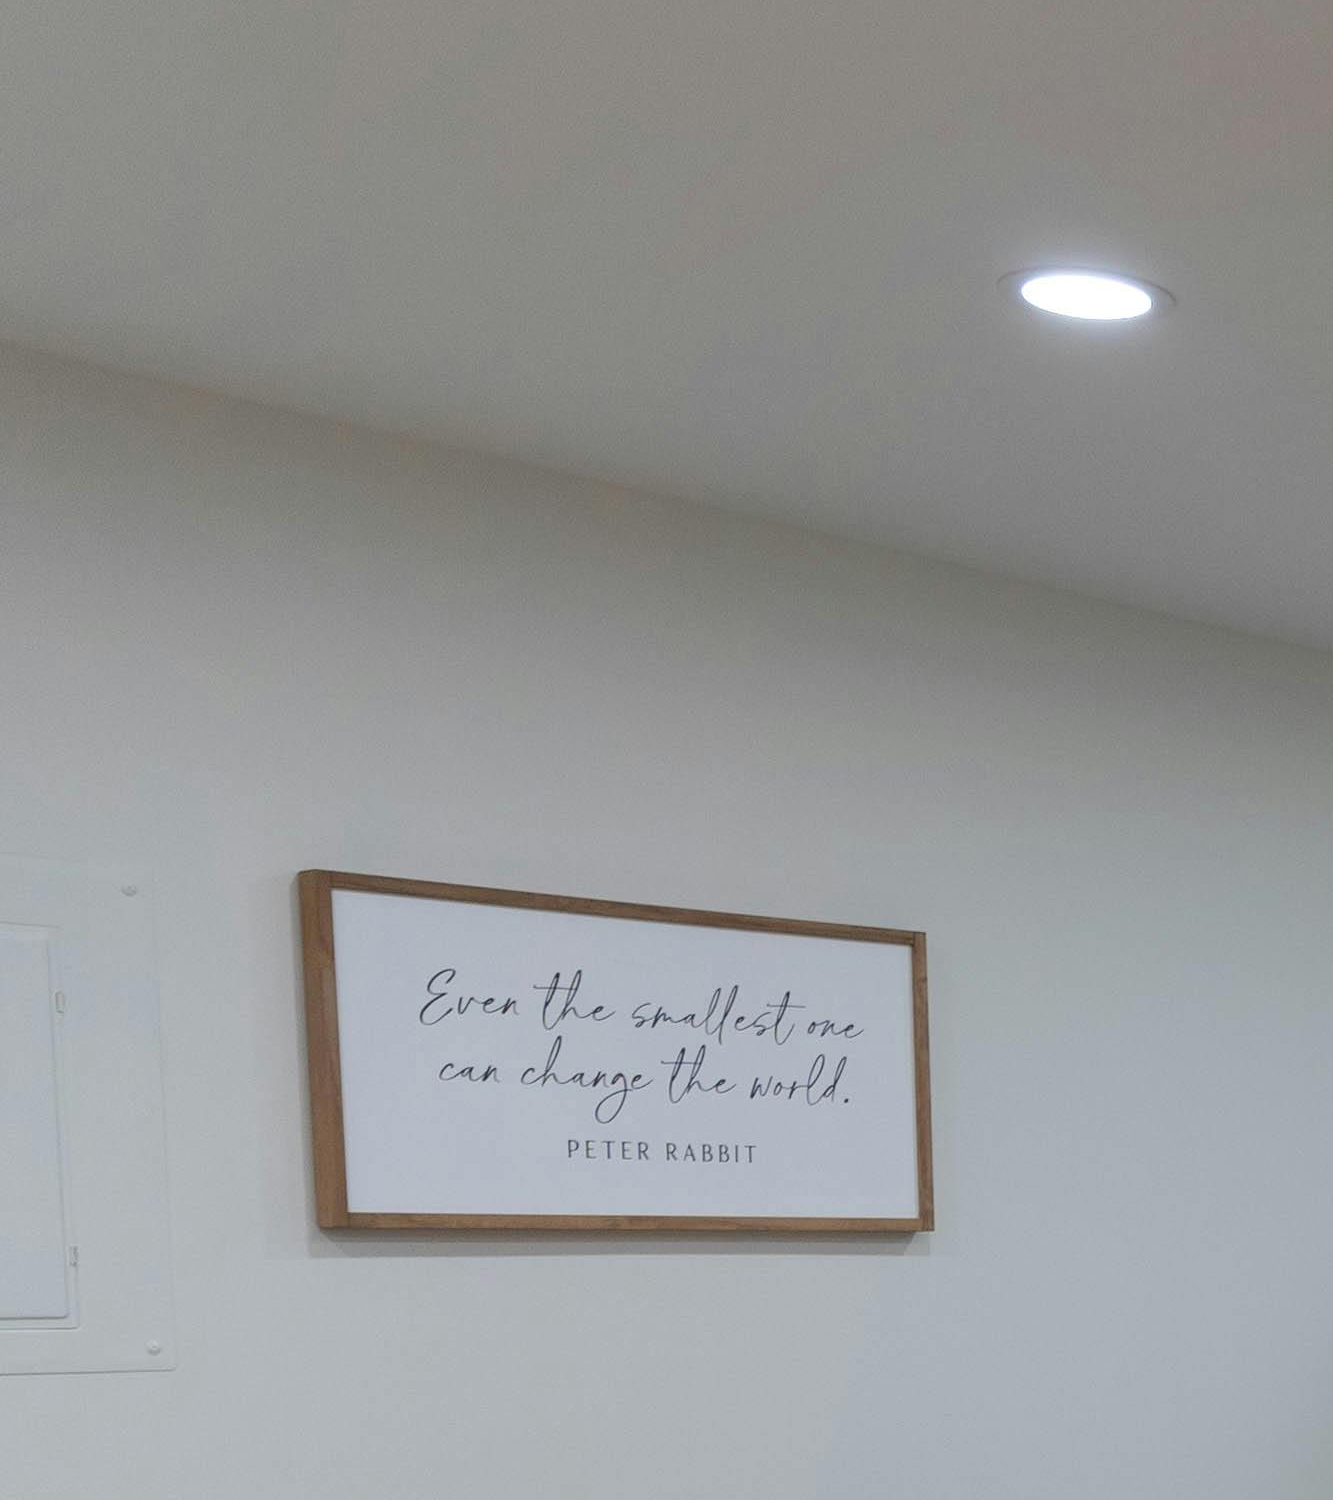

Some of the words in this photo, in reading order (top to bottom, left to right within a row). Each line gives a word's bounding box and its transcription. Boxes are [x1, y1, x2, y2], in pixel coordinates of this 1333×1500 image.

[420, 969, 520, 1026] Even
[533, 971, 615, 1031] the
[631, 985, 805, 1046] smallest
[807, 1015, 864, 1040] one
[438, 1057, 500, 1085] can
[520, 1036, 653, 1123] change
[660, 1045, 736, 1105] the
[749, 1054, 852, 1106] world.
[566, 1138, 650, 1162] PETER
[665, 1142, 758, 1165] RABBIT
